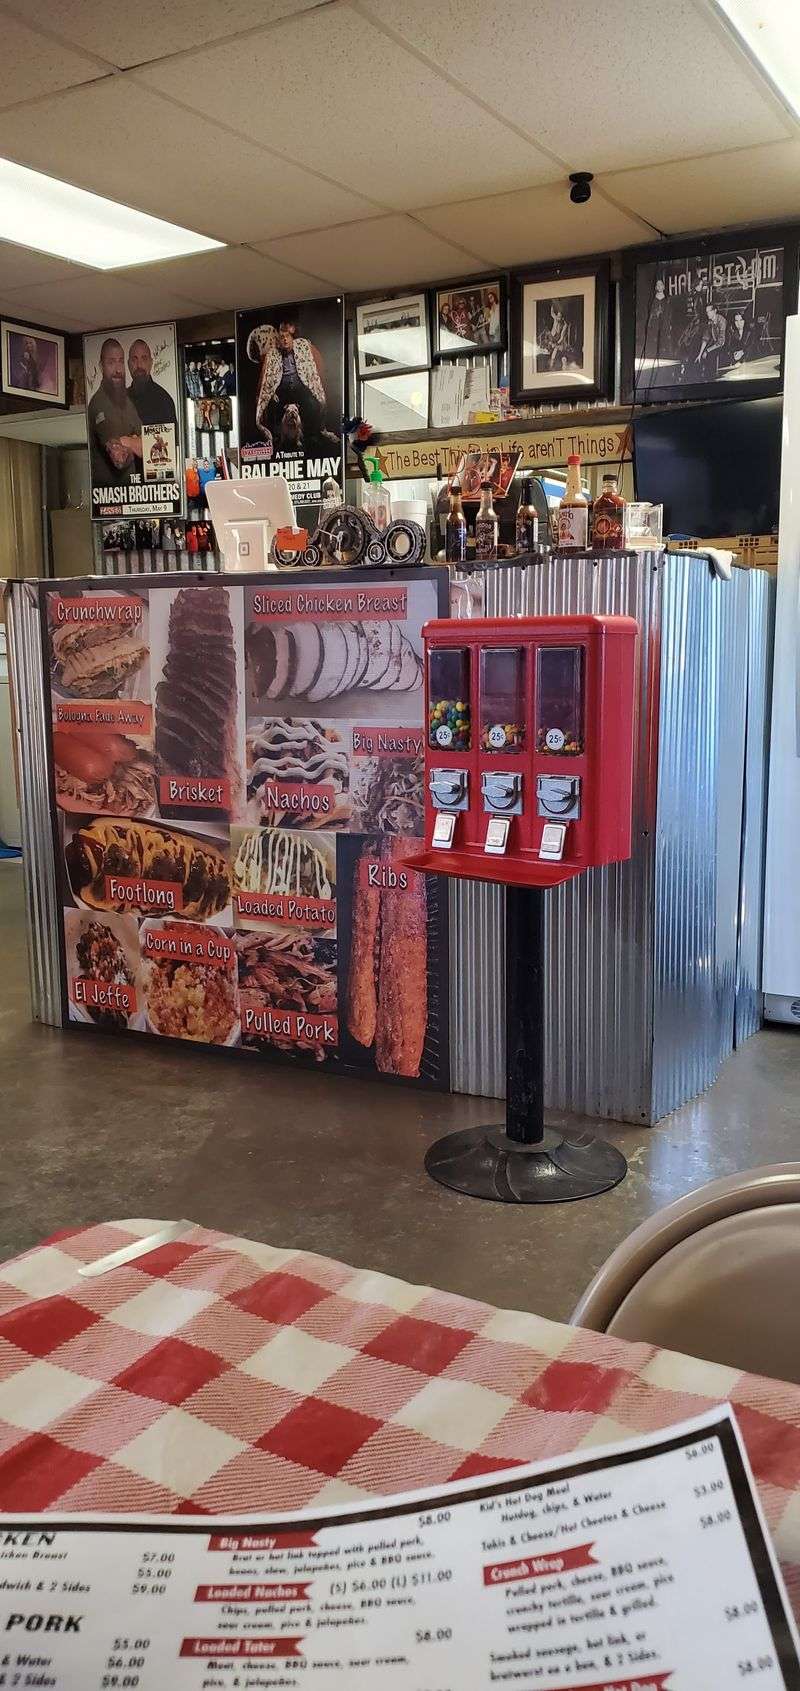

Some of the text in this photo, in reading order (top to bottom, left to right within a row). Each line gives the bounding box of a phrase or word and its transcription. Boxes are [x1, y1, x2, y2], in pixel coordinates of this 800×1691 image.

[387, 451, 411, 467] The
[413, 449, 440, 467] Best
[570, 435, 615, 457] Things
[130, 473, 141, 484] THE
[306, 456, 341, 478] MAY
[93, 483, 180, 504] SMASH BROTHERS
[57, 600, 143, 624] Crunchwrap
[253, 592, 408, 614] Sliced Chicken Breast
[57, 708, 94, 725] Bologna
[118, 709, 145, 727] Away
[352, 731, 421, 755] Big Nasty
[168, 780, 224, 804] Brisket
[265, 787, 330, 812] Nachos
[367, 863, 408, 889] Ribs
[109, 878, 175, 909] Footlong
[237, 896, 336, 923] Loaded Potato
[145, 932, 232, 963] Corn in a Cup
[74, 981, 131, 1009] El Jeffe
[245, 1008, 336, 1042] Pulled Pork
[219, 1535, 277, 1550] Big Nasty
[62, 1580, 92, 1592] Sides
[5, 1613, 84, 1633] PORK
